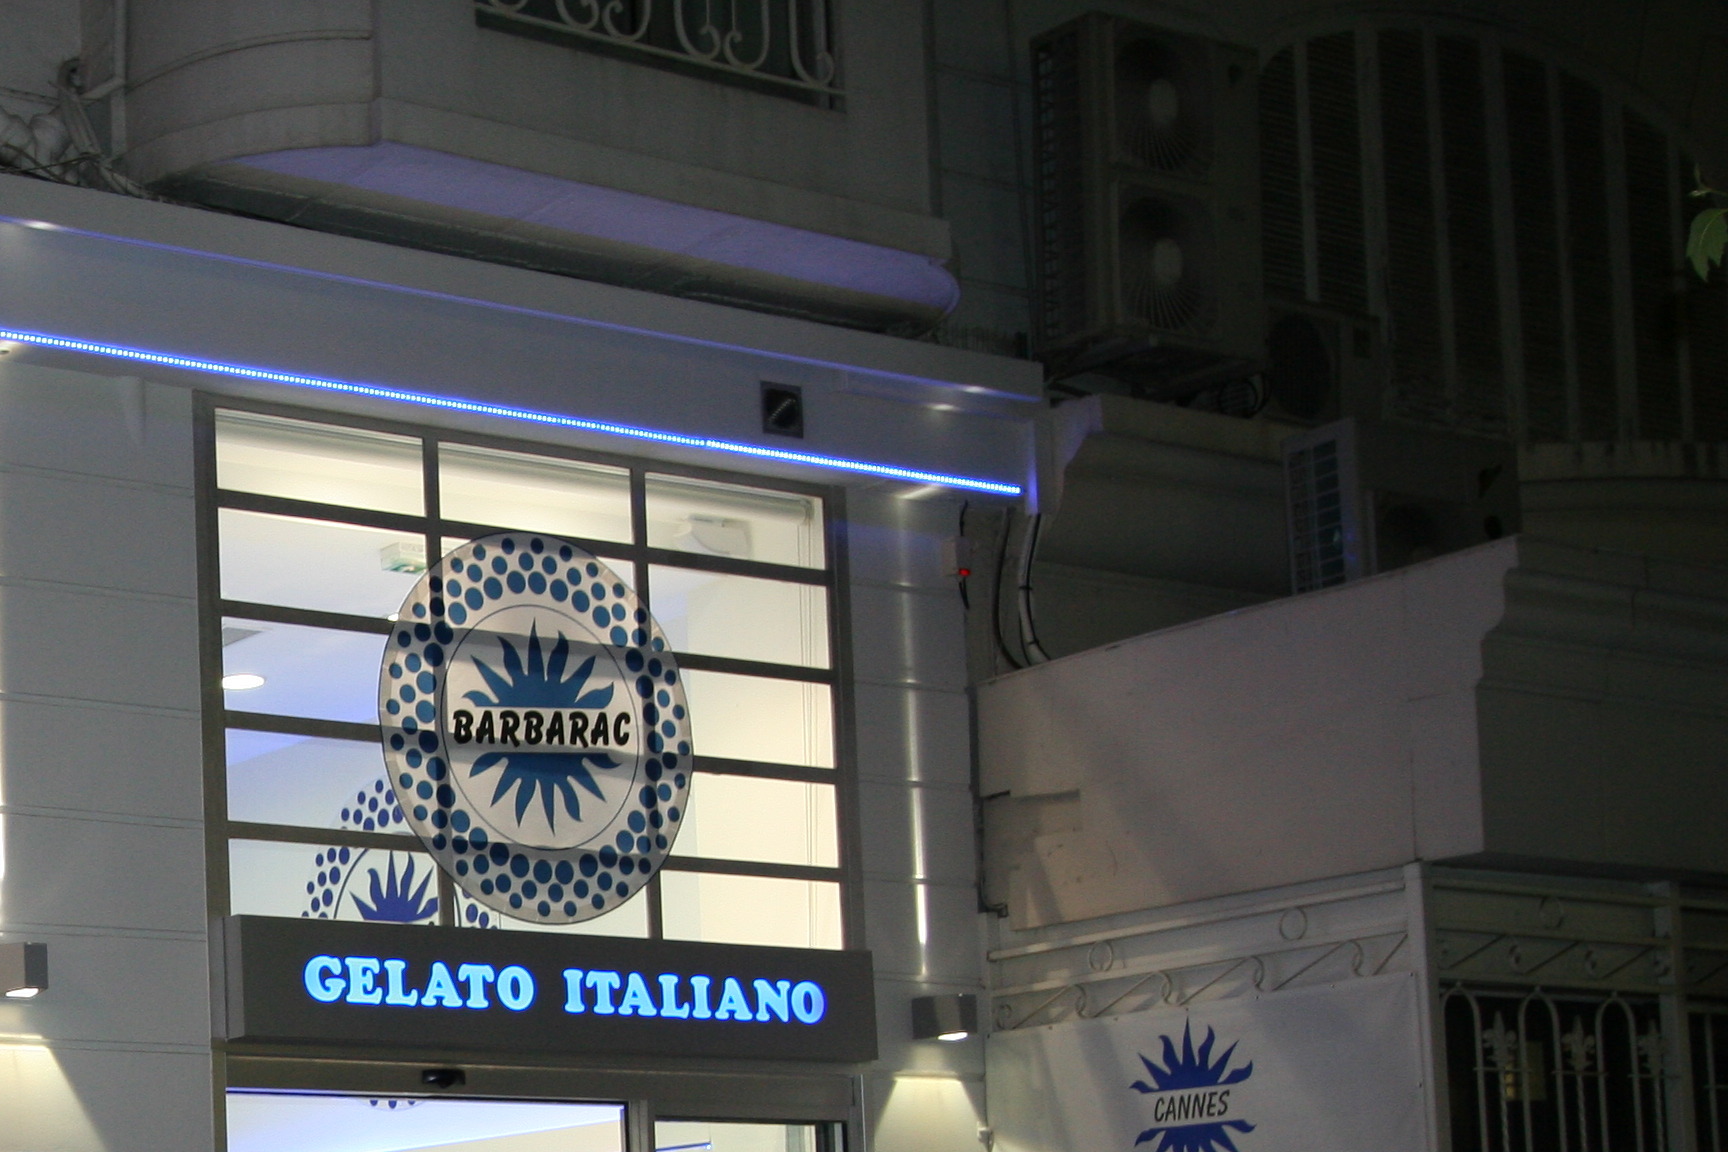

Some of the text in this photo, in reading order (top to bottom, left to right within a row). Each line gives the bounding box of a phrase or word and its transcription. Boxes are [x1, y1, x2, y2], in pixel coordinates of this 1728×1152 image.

[452, 709, 631, 749] BARBARAC
[302, 953, 826, 1025] GELATO ITALIANO
[1154, 1089, 1230, 1123] CANNES
